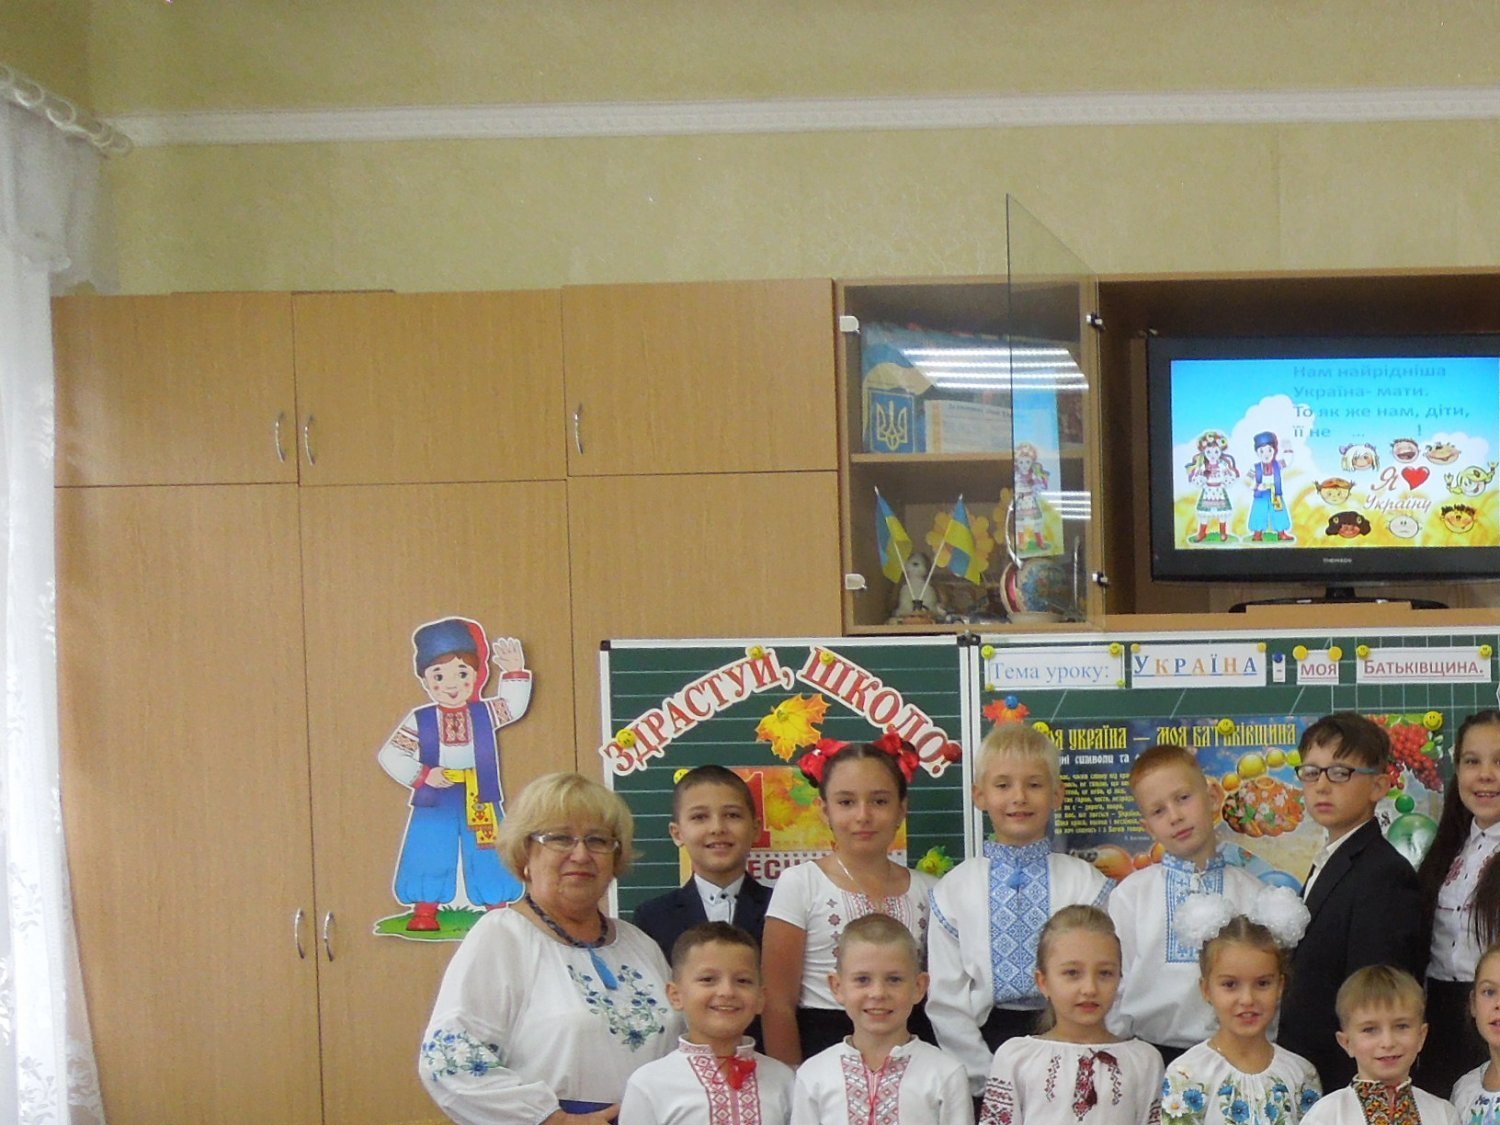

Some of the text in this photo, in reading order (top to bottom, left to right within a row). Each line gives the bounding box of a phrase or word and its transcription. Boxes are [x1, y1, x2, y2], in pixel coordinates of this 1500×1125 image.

[1292, 364, 1447, 380] Нам найрідніша
[1376, 387, 1430, 398] мати.
[1293, 404, 1471, 420] То як же нам, діти,
[1309, 428, 1332, 437] не
[1134, 655, 1257, 676] УКРАЇНА
[1300, 661, 1337, 677] МОЯ
[1364, 659, 1484, 677] БАТЬКІВЩИНА.
[990, 661, 1110, 688] Тема уроку:
